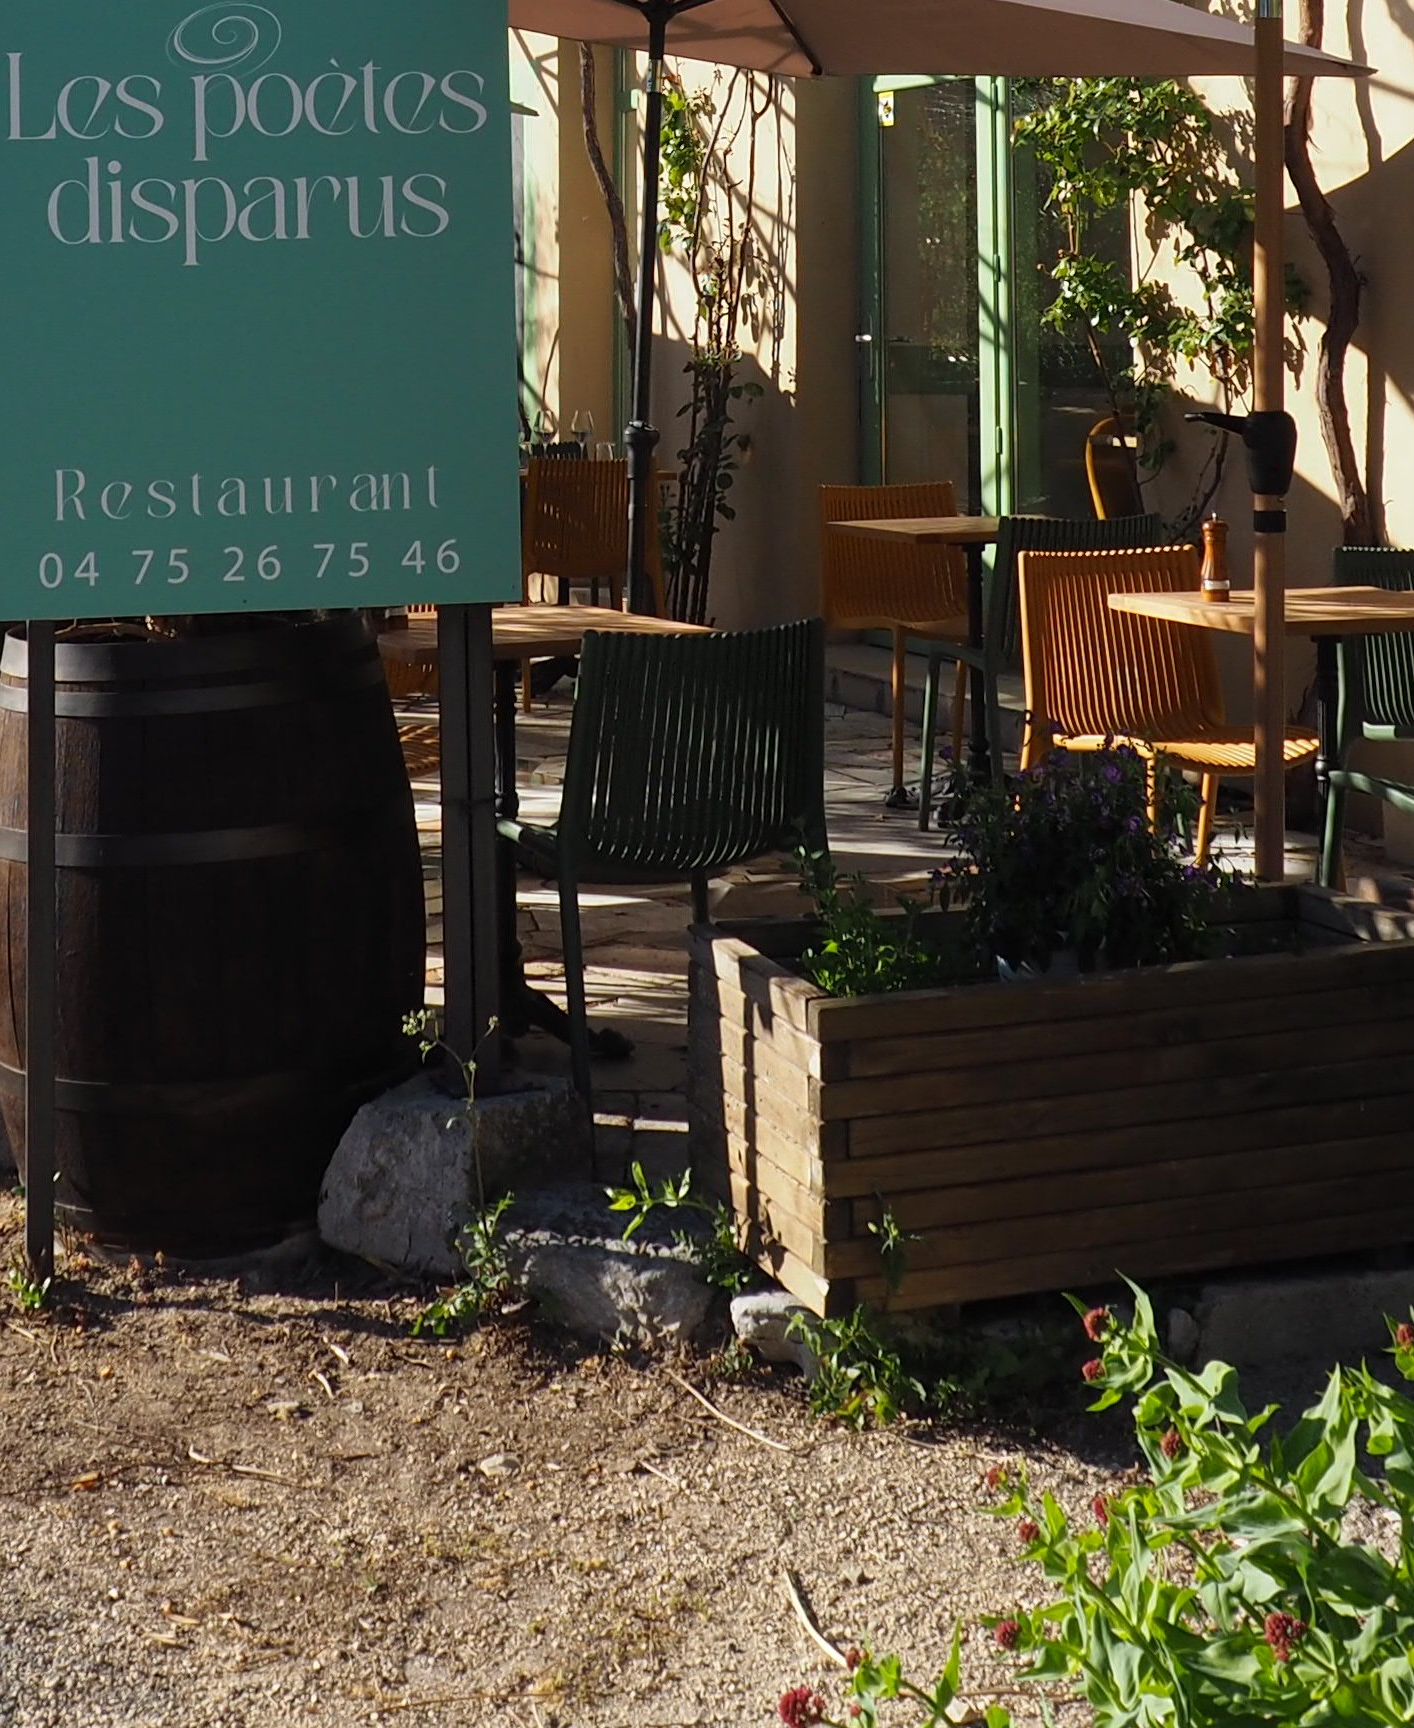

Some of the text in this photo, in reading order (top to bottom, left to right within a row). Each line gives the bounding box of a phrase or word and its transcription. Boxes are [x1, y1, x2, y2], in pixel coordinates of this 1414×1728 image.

[6, 51, 488, 162] Les poètes
[47, 156, 450, 266] disparus
[53, 465, 441, 522] Restaurant
[38, 537, 461, 590] 04 75 26 75 46
